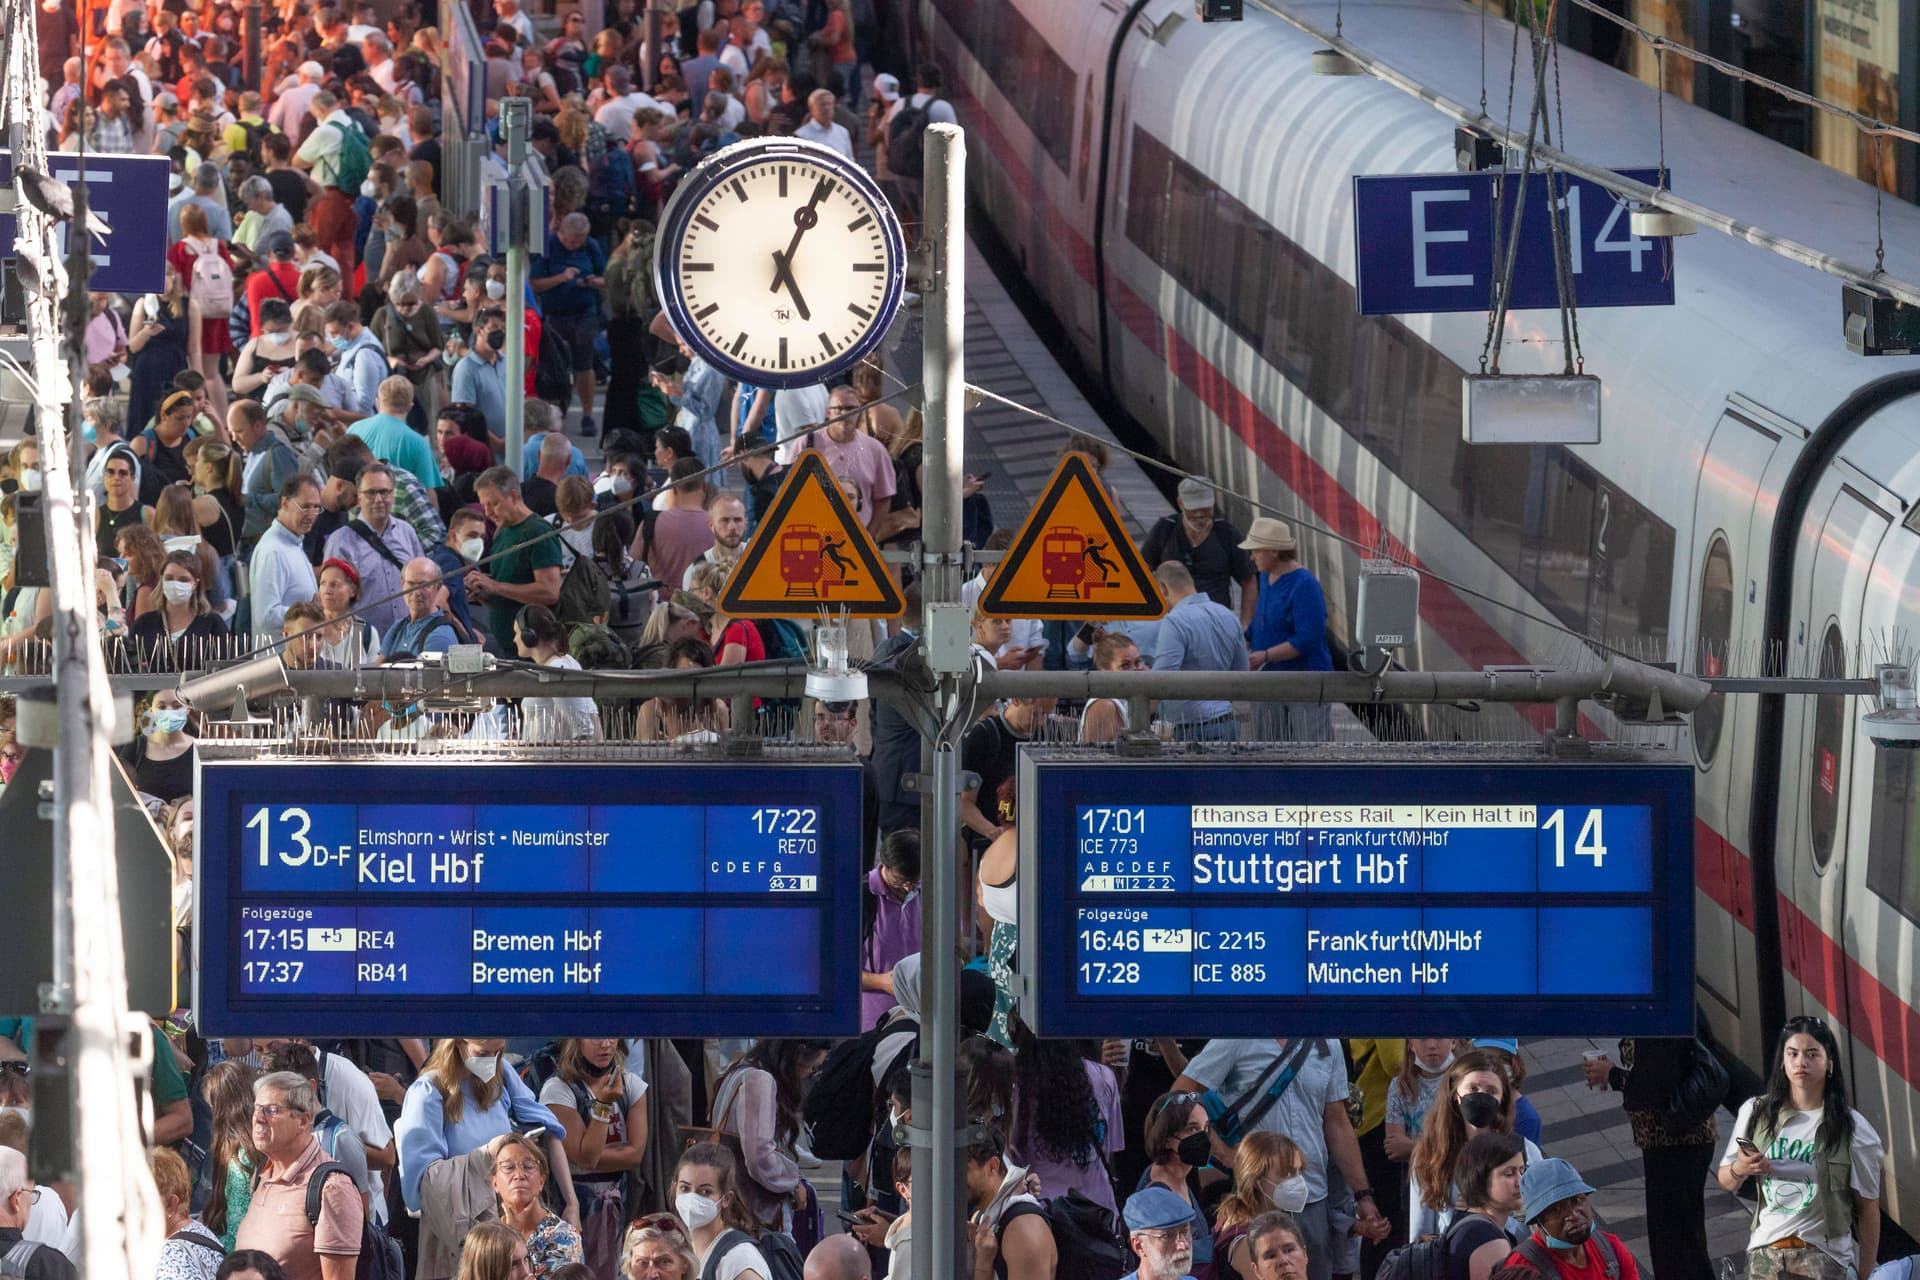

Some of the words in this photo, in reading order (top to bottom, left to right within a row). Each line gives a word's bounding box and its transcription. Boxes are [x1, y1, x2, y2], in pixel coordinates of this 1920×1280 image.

[1411, 189, 1474, 288] E
[1547, 185, 1653, 273] 14
[751, 808, 816, 834] 17:22
[1082, 808, 1145, 834] 17:01
[1274, 807, 1353, 827] Express
[1360, 808, 1394, 823] Rail
[1425, 808, 1466, 823] Kein
[1472, 807, 1512, 823] Halt
[1519, 807, 1535, 822] in
[245, 807, 312, 867] 13
[313, 845, 352, 867] D-F
[359, 829, 433, 846] Elmshorn
[450, 829, 495, 846] Wrist
[512, 830, 610, 846] Neumünster
[778, 838, 816, 854] RE70
[1080, 838, 1104, 854] ICE
[1109, 838, 1138, 854] 773
[1193, 831, 1269, 846] Hannover
[1274, 830, 1301, 846] Hbf
[1319, 830, 1449, 846] Frankfurt(M)Hbf
[1541, 808, 1608, 867] 14
[358, 852, 416, 883] Kiel
[430, 852, 484, 884] Hbf
[711, 861, 719, 873] C
[727, 861, 736, 873] D
[742, 861, 750, 873] E
[758, 861, 766, 873] F
[773, 861, 782, 873] G
[1084, 862, 1094, 873] A
[1101, 861, 1109, 873] B
[1116, 861, 1124, 873] C
[1132, 861, 1141, 873] D
[1147, 861, 1155, 873] E
[1163, 861, 1171, 873] F
[1193, 853, 1342, 892] Stuttgart
[1356, 853, 1408, 884] Hbf
[242, 907, 313, 921] Folgezüge
[1078, 908, 1148, 922] Folgezüge
[243, 928, 304, 950] 17:15
[320, 928, 342, 943] +5
[358, 930, 395, 949] RE4
[473, 929, 554, 951] Bremen
[564, 930, 602, 951] Hbf
[1080, 930, 1140, 951] 16:46
[1151, 930, 1184, 944] +25
[1193, 931, 1211, 950] IC
[1219, 931, 1266, 950] 2215
[1307, 930, 1482, 951] Frankfurt(M)Hbf
[243, 961, 304, 983] 17:37
[358, 963, 407, 982] RB41
[472, 962, 554, 984] Bremen
[564, 962, 602, 984] Hbf
[1079, 962, 1140, 984] 17:28
[1193, 964, 1223, 982] ICE
[1231, 963, 1266, 982] 885
[1308, 962, 1402, 984] München
[1411, 962, 1449, 984] Hbf
